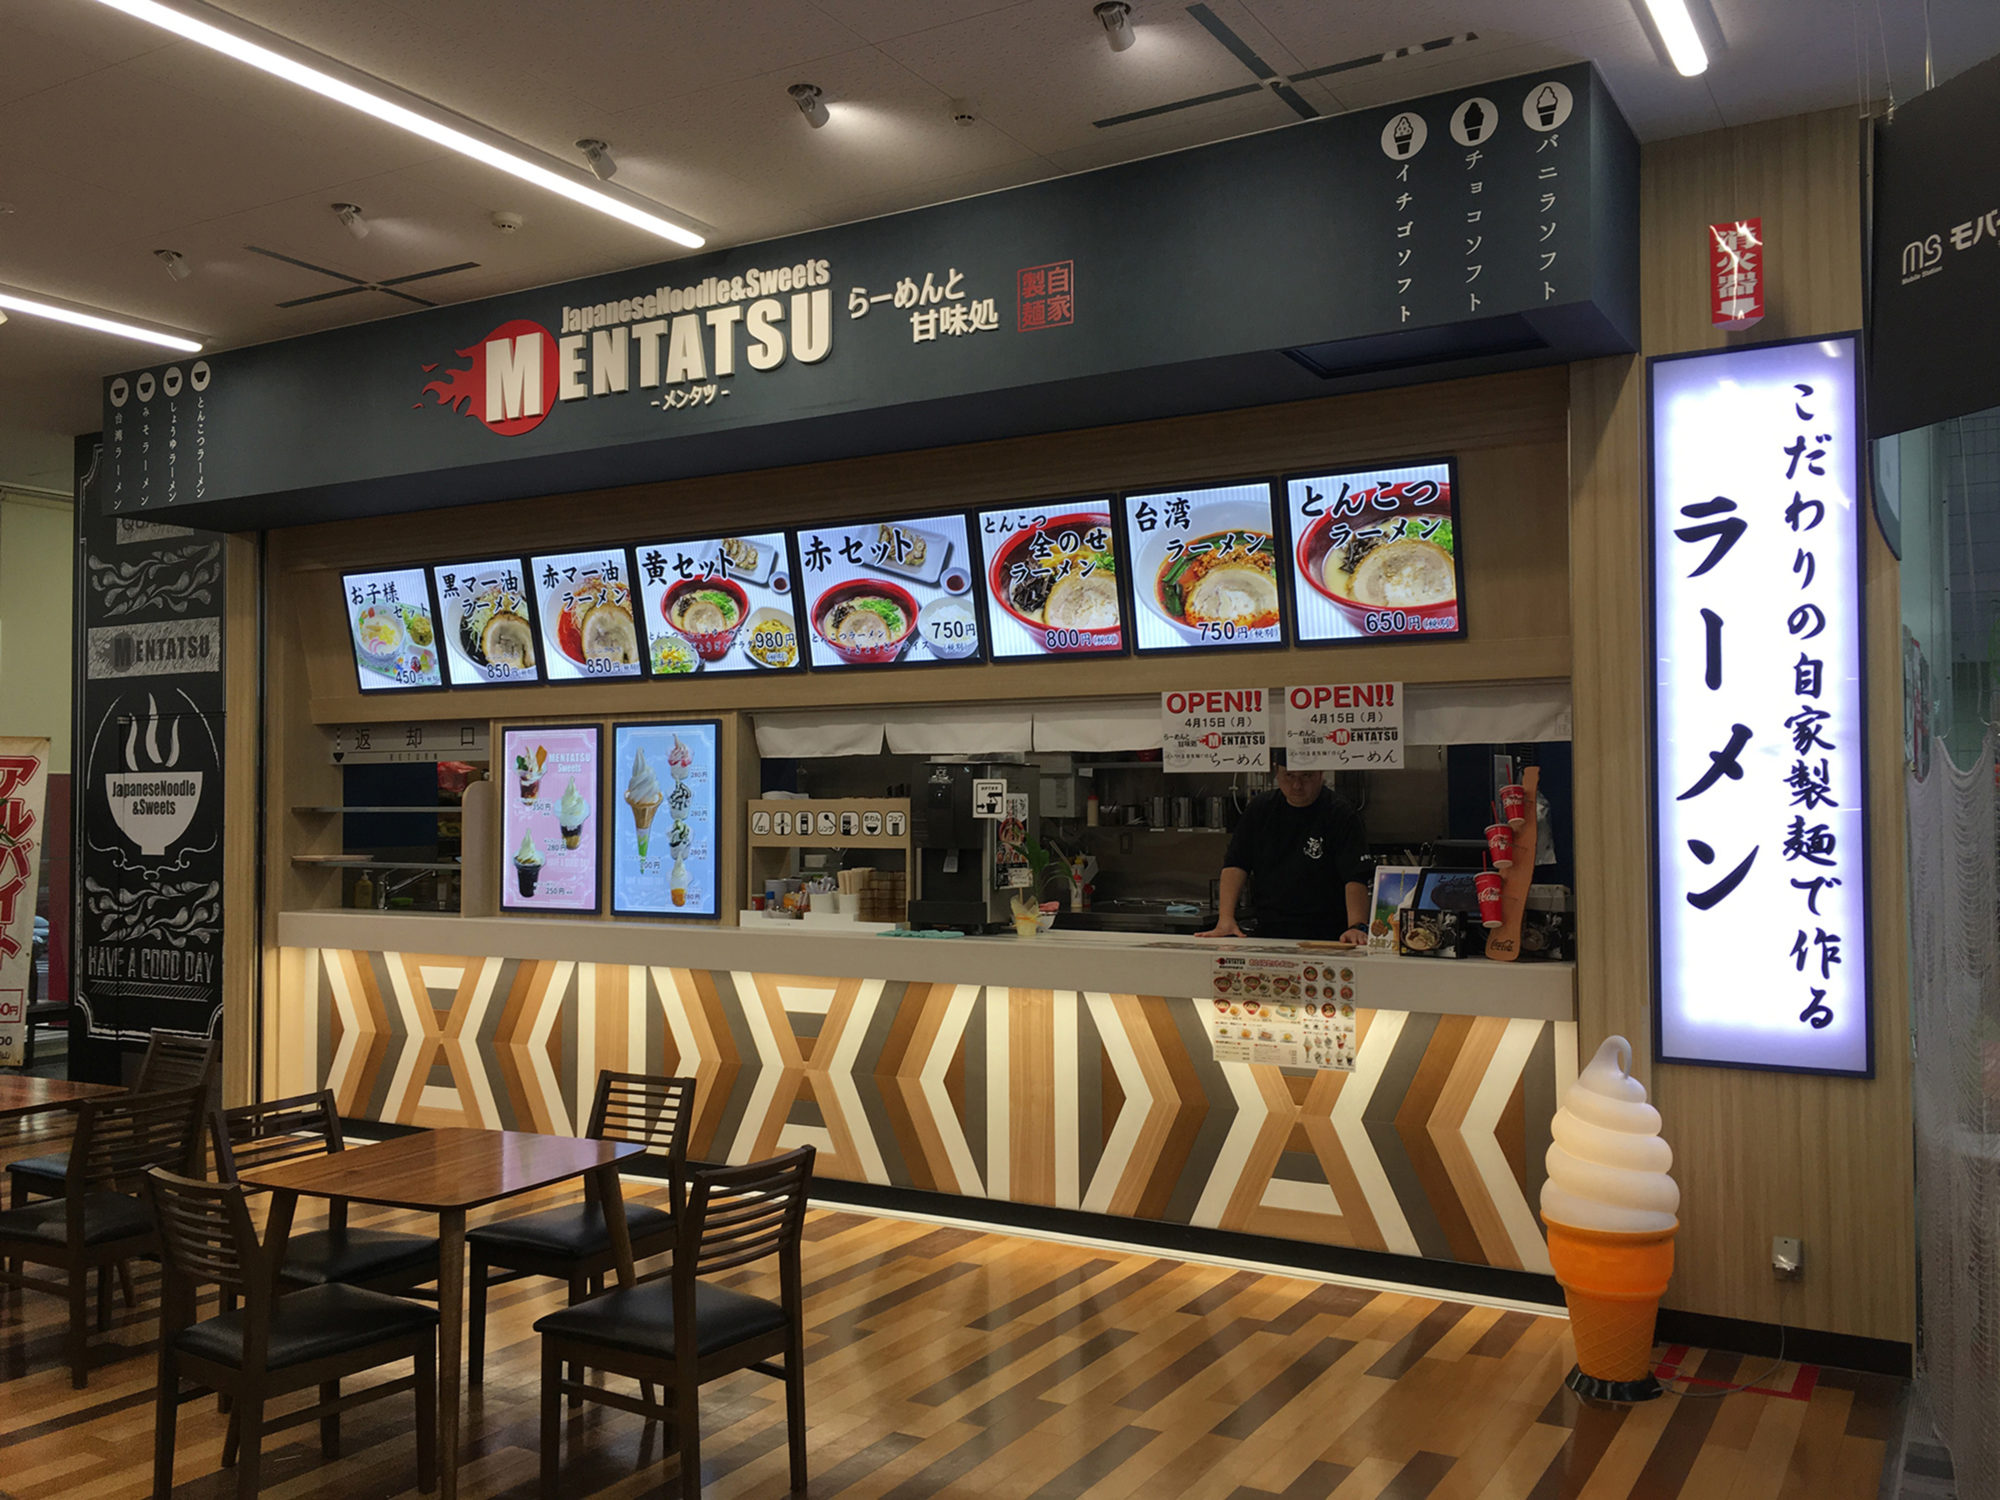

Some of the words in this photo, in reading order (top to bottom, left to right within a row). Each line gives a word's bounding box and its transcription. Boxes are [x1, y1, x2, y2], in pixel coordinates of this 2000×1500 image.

[1465, 150, 1484, 312] チョコソフト
[1536, 133, 1560, 300] バニラソフト
[1950, 208, 2000, 251] モバ
[1395, 164, 1414, 322] イチゴソフト
[1715, 227, 1760, 299] 消火器
[561, 258, 832, 334] JapaneseNoodle&Sweets
[848, 267, 966, 319] らーめんと
[909, 298, 999, 344] 甘味処
[486, 288, 834, 423] MENTATSU
[141, 407, 151, 507] みそラーメン
[168, 402, 177, 503] しょうゆラーメン
[196, 395, 206, 499] とんこつラーメン
[1301, 480, 1439, 518] とんこつ
[984, 514, 1047, 534] とんこつ
[1135, 499, 1191, 532] 台湾
[1031, 528, 1108, 560] 全のせ
[1166, 533, 1267, 563] ラーメン
[1331, 518, 1441, 549] ラーメン
[804, 528, 912, 573] 赤セット
[543, 562, 620, 590] 赤マー油
[641, 547, 736, 587] 黄セット
[1010, 559, 1097, 583] ラーメン
[351, 581, 400, 606] お子様
[444, 569, 519, 600] 黒マー油
[563, 588, 629, 612] ラーメン
[393, 602, 429, 620] セット
[463, 595, 524, 616] ラーメン
[755, 630, 796, 649] 980円
[931, 620, 976, 640] 750円
[113, 633, 211, 668] MENTATSU
[1166, 690, 1262, 714] OPEN!!
[1290, 684, 1394, 710] OPEN!!
[1674, 496, 1760, 911] ラーメン
[1783, 383, 1843, 1030] こだわりの自家製麺で作る
[354, 726, 476, 751] 返却口
[1208, 734, 1266, 747] MENTATSU
[1335, 730, 1399, 743] MENTATSU
[1210, 753, 1265, 767] らーめん
[1339, 749, 1397, 765] らーめん
[112, 780, 196, 799] JapaneseNoodle
[132, 798, 176, 816] &Sweets
[88, 945, 125, 978] HAVE
[127, 947, 137, 978] A
[184, 950, 214, 983] DAY
